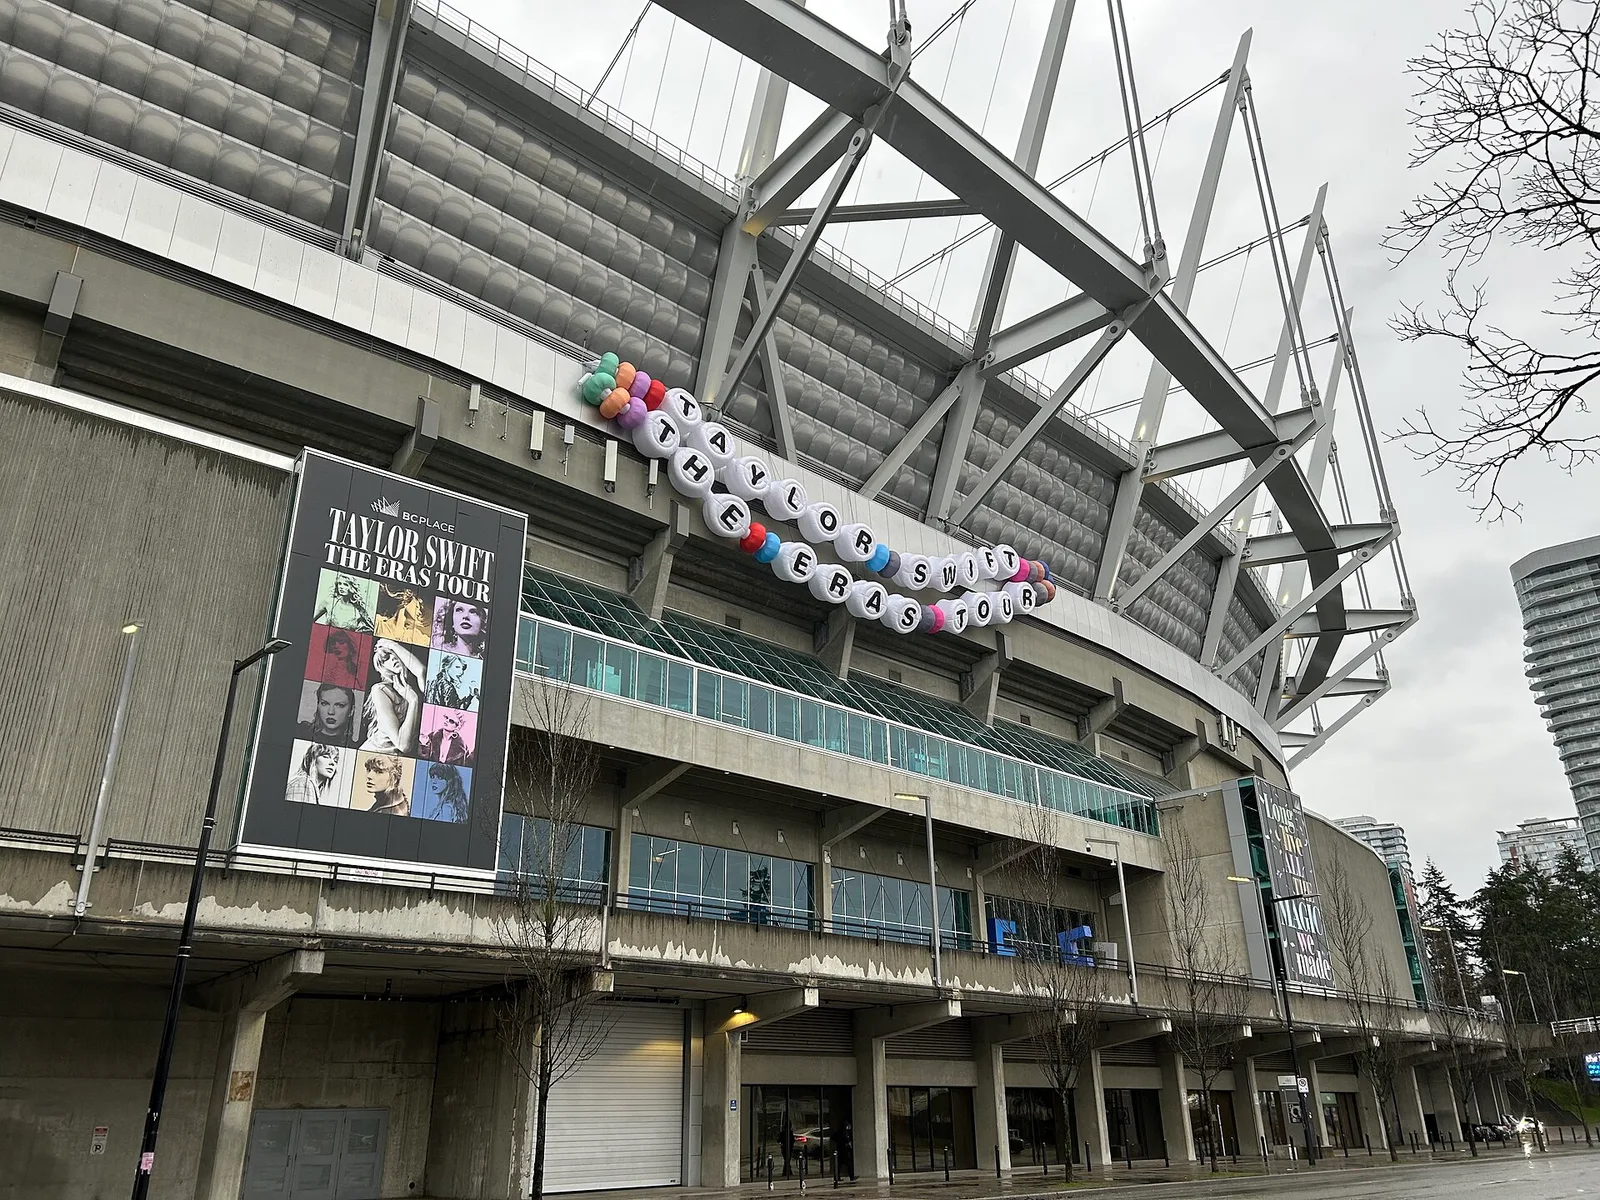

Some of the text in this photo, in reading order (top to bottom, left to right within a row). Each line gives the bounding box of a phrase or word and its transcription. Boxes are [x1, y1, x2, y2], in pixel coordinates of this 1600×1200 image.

[680, 395, 1015, 585] TAYLOR SWIFT
[329, 507, 495, 583] TAYLOR SWIFT
[659, 419, 1033, 628] THE ERAS TOUR
[324, 543, 491, 604] THE ERAS TOUR
[1263, 792, 1296, 835] Long
[1279, 825, 1304, 857] live
[1277, 894, 1324, 936] MAGIC
[1296, 950, 1333, 981] made
